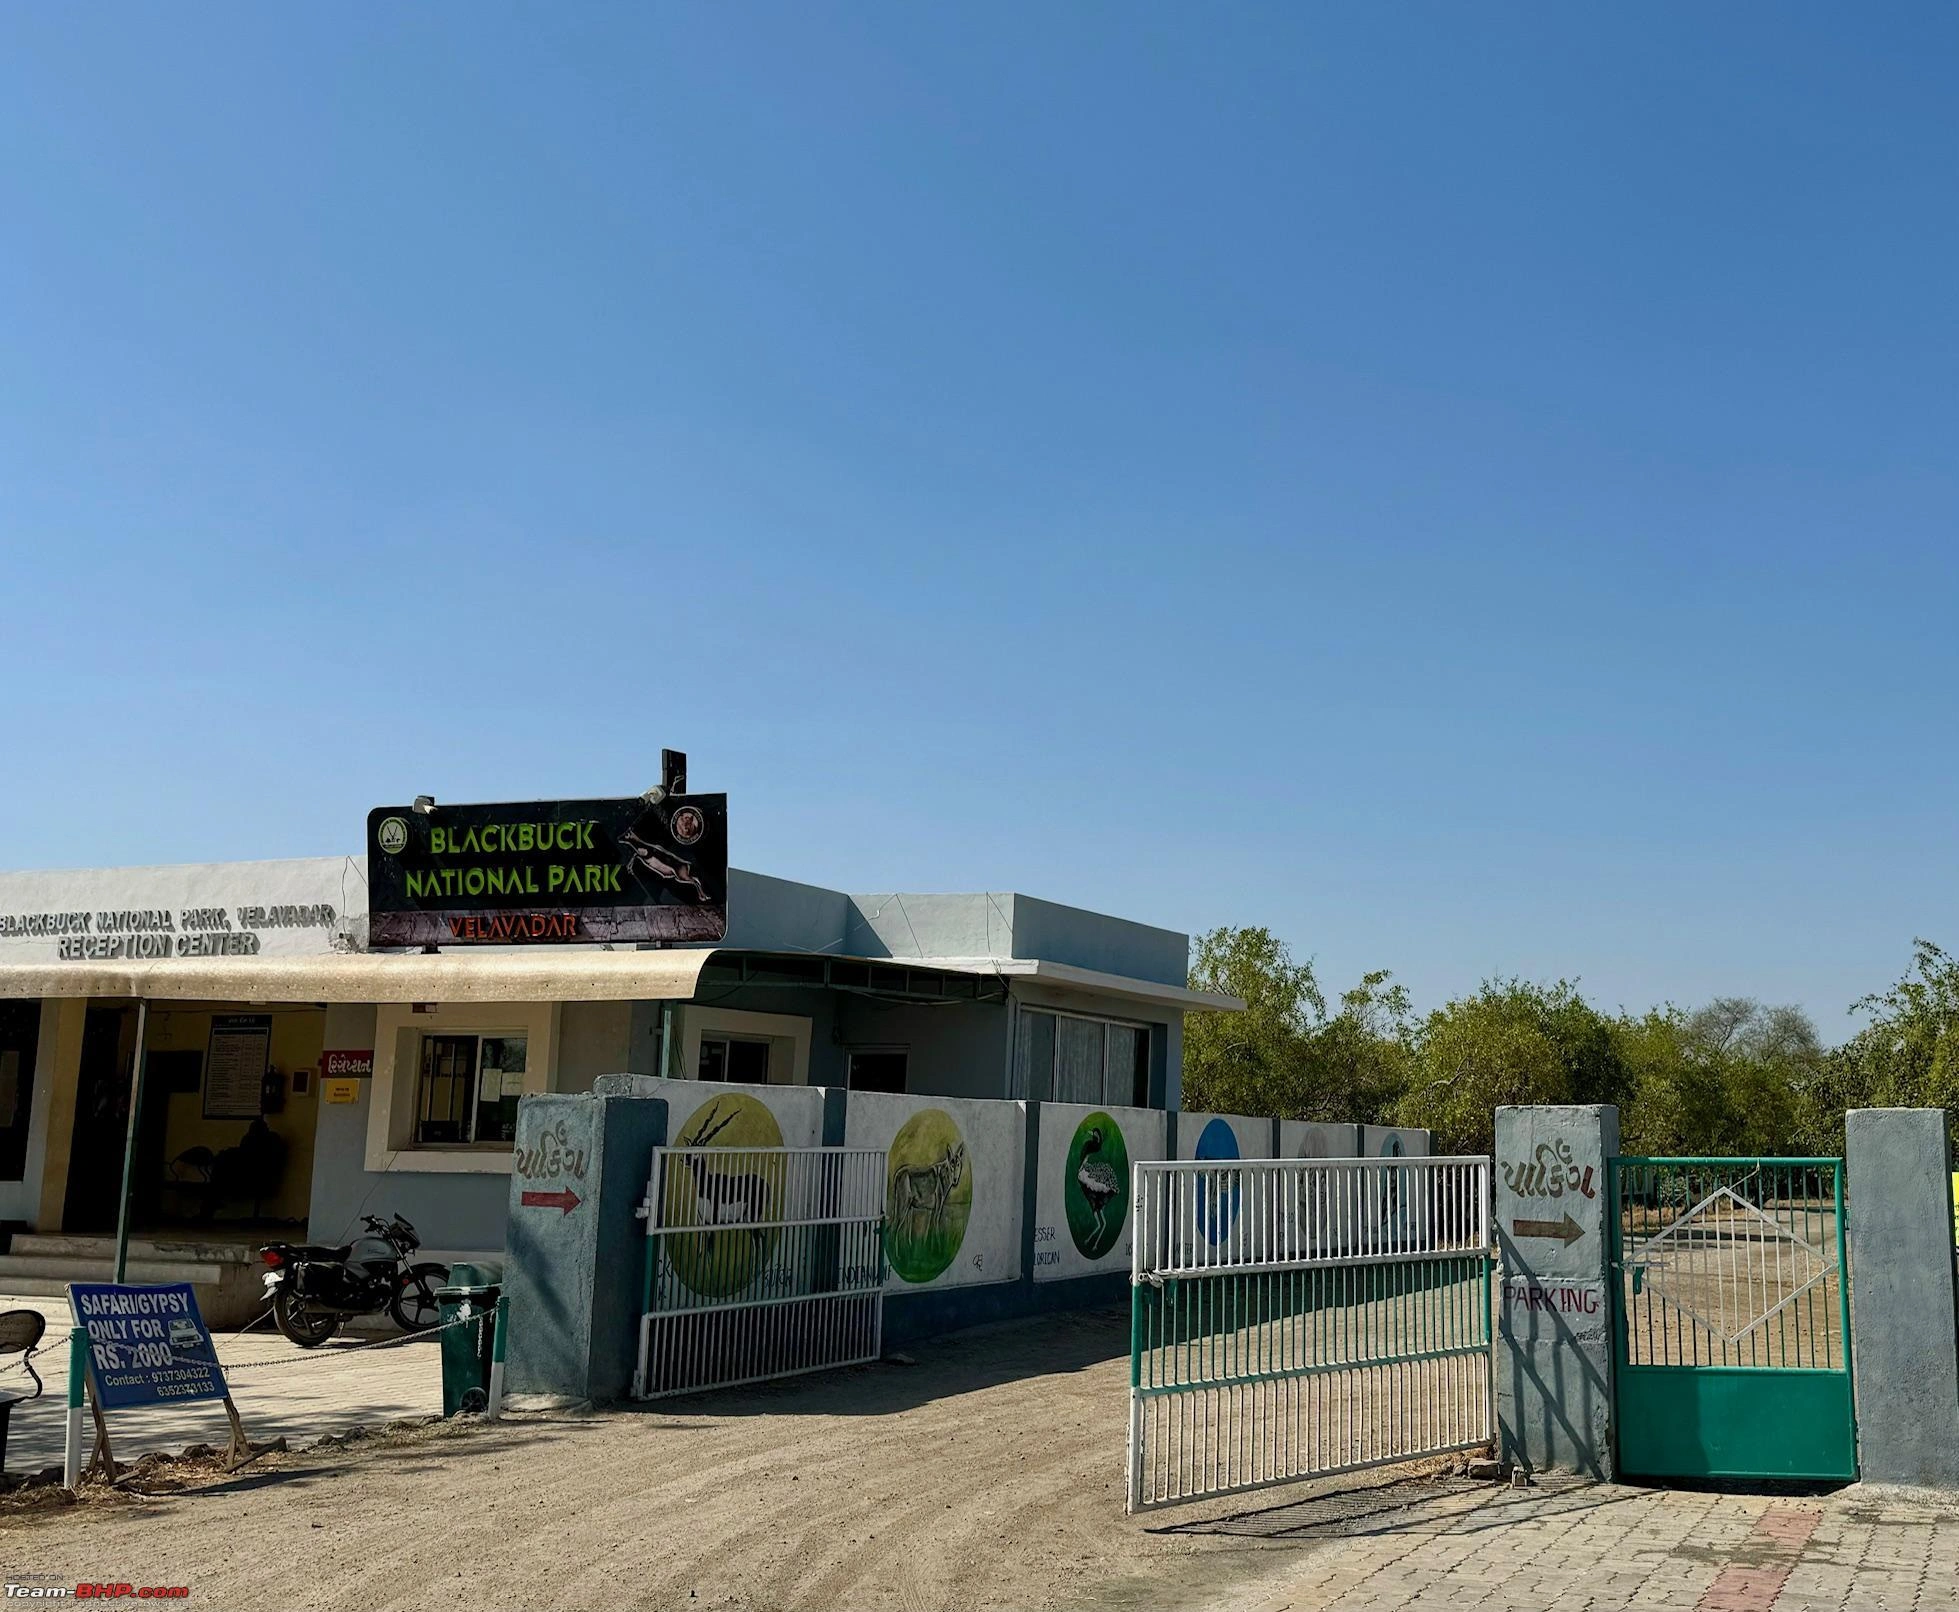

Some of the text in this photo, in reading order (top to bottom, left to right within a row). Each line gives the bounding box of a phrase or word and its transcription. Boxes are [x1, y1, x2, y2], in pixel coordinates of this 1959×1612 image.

[431, 820, 594, 854] BLACKBUCK
[405, 864, 622, 897] NATIONAL PARK
[95, 910, 175, 932] NATIONAL
[179, 907, 231, 932] PARK,
[236, 903, 335, 929] VELAVADAR
[449, 913, 577, 938] VELAVADAR
[58, 932, 260, 960] RECEPTION CENTER
[80, 1292, 189, 1315] SAFARI/GYPSY
[1503, 1285, 1600, 1315] PARKING
[87, 1319, 165, 1340] ONLY FOR
[92, 1343, 126, 1370] RS.
[104, 1374, 145, 1387] Contact
[151, 1367, 210, 1383] 9737304322
